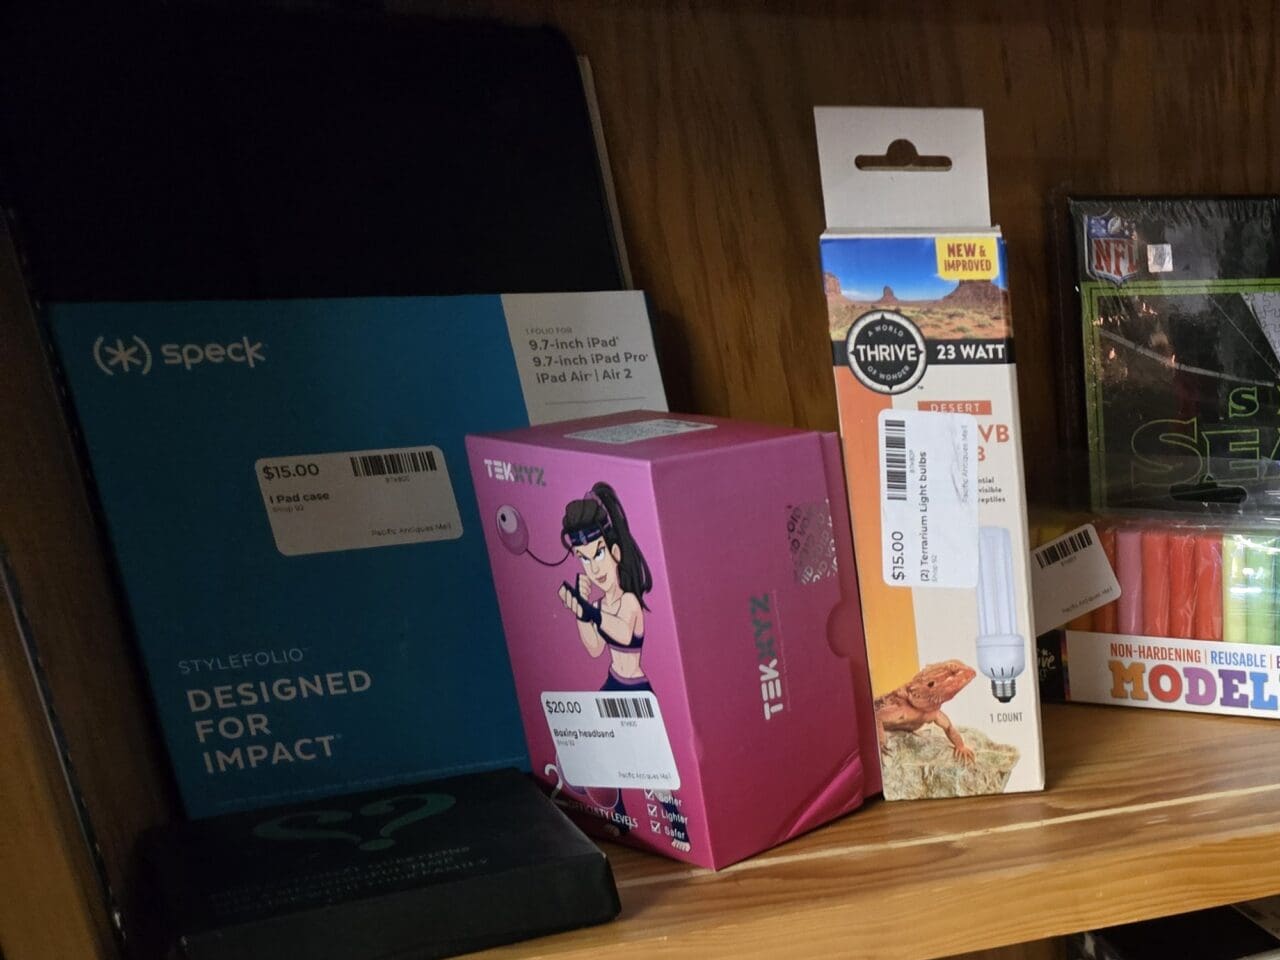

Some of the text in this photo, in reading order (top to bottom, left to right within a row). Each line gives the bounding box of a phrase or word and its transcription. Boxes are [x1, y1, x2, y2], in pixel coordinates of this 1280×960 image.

[947, 242, 986, 257] NEW &
[1094, 237, 1138, 277] NFL
[944, 259, 992, 272] IMPROVED
[528, 336, 617, 351] 9.7-inch iPad
[856, 344, 918, 361] THRIVE
[936, 344, 1004, 360] 23 WATT
[161, 336, 266, 370] speck
[533, 351, 647, 367] 9.7-inch iPad Pro
[536, 368, 633, 384] iPad Air Air 2
[262, 463, 320, 481] $15.00
[918, 452, 927, 482] bulbs
[277, 492, 330, 503] Pad case
[919, 485, 929, 512] Light
[920, 516, 928, 566] Terrarium
[892, 531, 905, 580] $15.00
[178, 648, 304, 675] STYLEFOLIO
[1110, 643, 1201, 663] NON-HARDENING
[1210, 651, 1266, 668] REUSABLE
[187, 670, 372, 712] DESIGNED
[546, 700, 582, 714] $20.00
[990, 712, 1023, 723] 1 COUNT
[195, 713, 272, 743] FOR
[553, 728, 615, 740] Boxing headband
[203, 735, 335, 774] IMPACT
